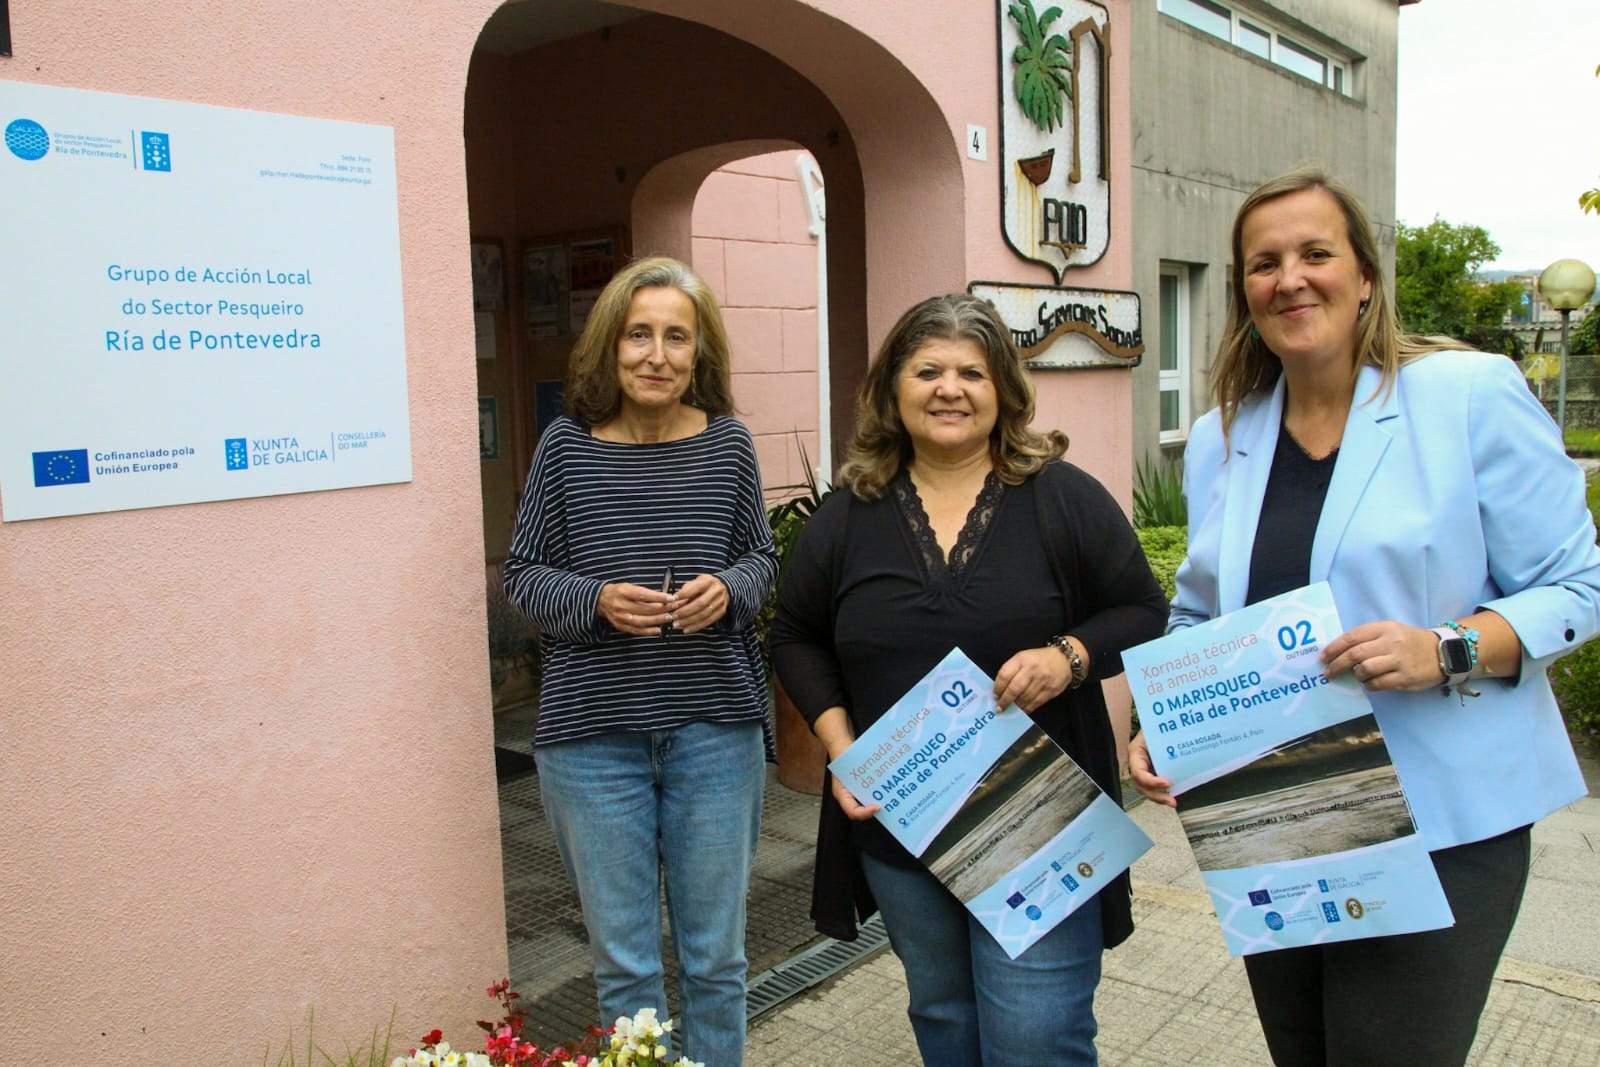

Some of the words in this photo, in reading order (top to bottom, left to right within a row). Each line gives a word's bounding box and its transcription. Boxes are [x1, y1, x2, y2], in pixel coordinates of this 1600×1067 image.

[972, 131, 980, 153] 4
[1043, 197, 1088, 245] POIO
[107, 265, 170, 287] Grupo
[174, 266, 198, 284] de
[202, 267, 262, 285] Acción
[266, 269, 312, 286] Local
[122, 298, 146, 316] do
[151, 299, 212, 315] Sector
[218, 300, 304, 319] Pesqueiro
[106, 330, 144, 351] Ría
[152, 330, 181, 350] de
[190, 329, 321, 350] Pontevedra
[95, 449, 169, 462] Cofinanciado
[172, 446, 195, 458] pola
[252, 437, 299, 451] XUNTA
[338, 442, 350, 450] DO
[351, 440, 368, 449] MAR
[96, 464, 130, 475] Unión
[132, 461, 178, 473] Europea
[253, 453, 270, 466] DE
[275, 449, 329, 465] GALICIA
[1278, 619, 1316, 651] 02
[1140, 653, 1200, 681] Xornada
[1203, 632, 1258, 660] técnica
[1285, 646, 1318, 661] OUTUBRO
[1147, 680, 1164, 696] da
[1167, 664, 1218, 690] ameixa
[941, 680, 973, 708] 02
[1152, 701, 1164, 716] O
[1167, 671, 1261, 712] MARISQUEO
[1158, 718, 1177, 734] na
[1180, 709, 1204, 728] Ría
[1208, 701, 1227, 719] de
[1230, 672, 1329, 712] Pontevedra
[850, 741, 893, 781] Xornada
[892, 707, 931, 742] técnica
[1177, 741, 1195, 750] CASA
[860, 776, 875, 790] da
[875, 743, 911, 779] ameixa
[872, 787, 884, 802] O
[881, 732, 947, 794] MARISQUEO
[884, 798, 899, 813] na
[897, 781, 918, 800] Ría
[916, 767, 933, 783] de
[930, 710, 996, 770] Pontevedra
